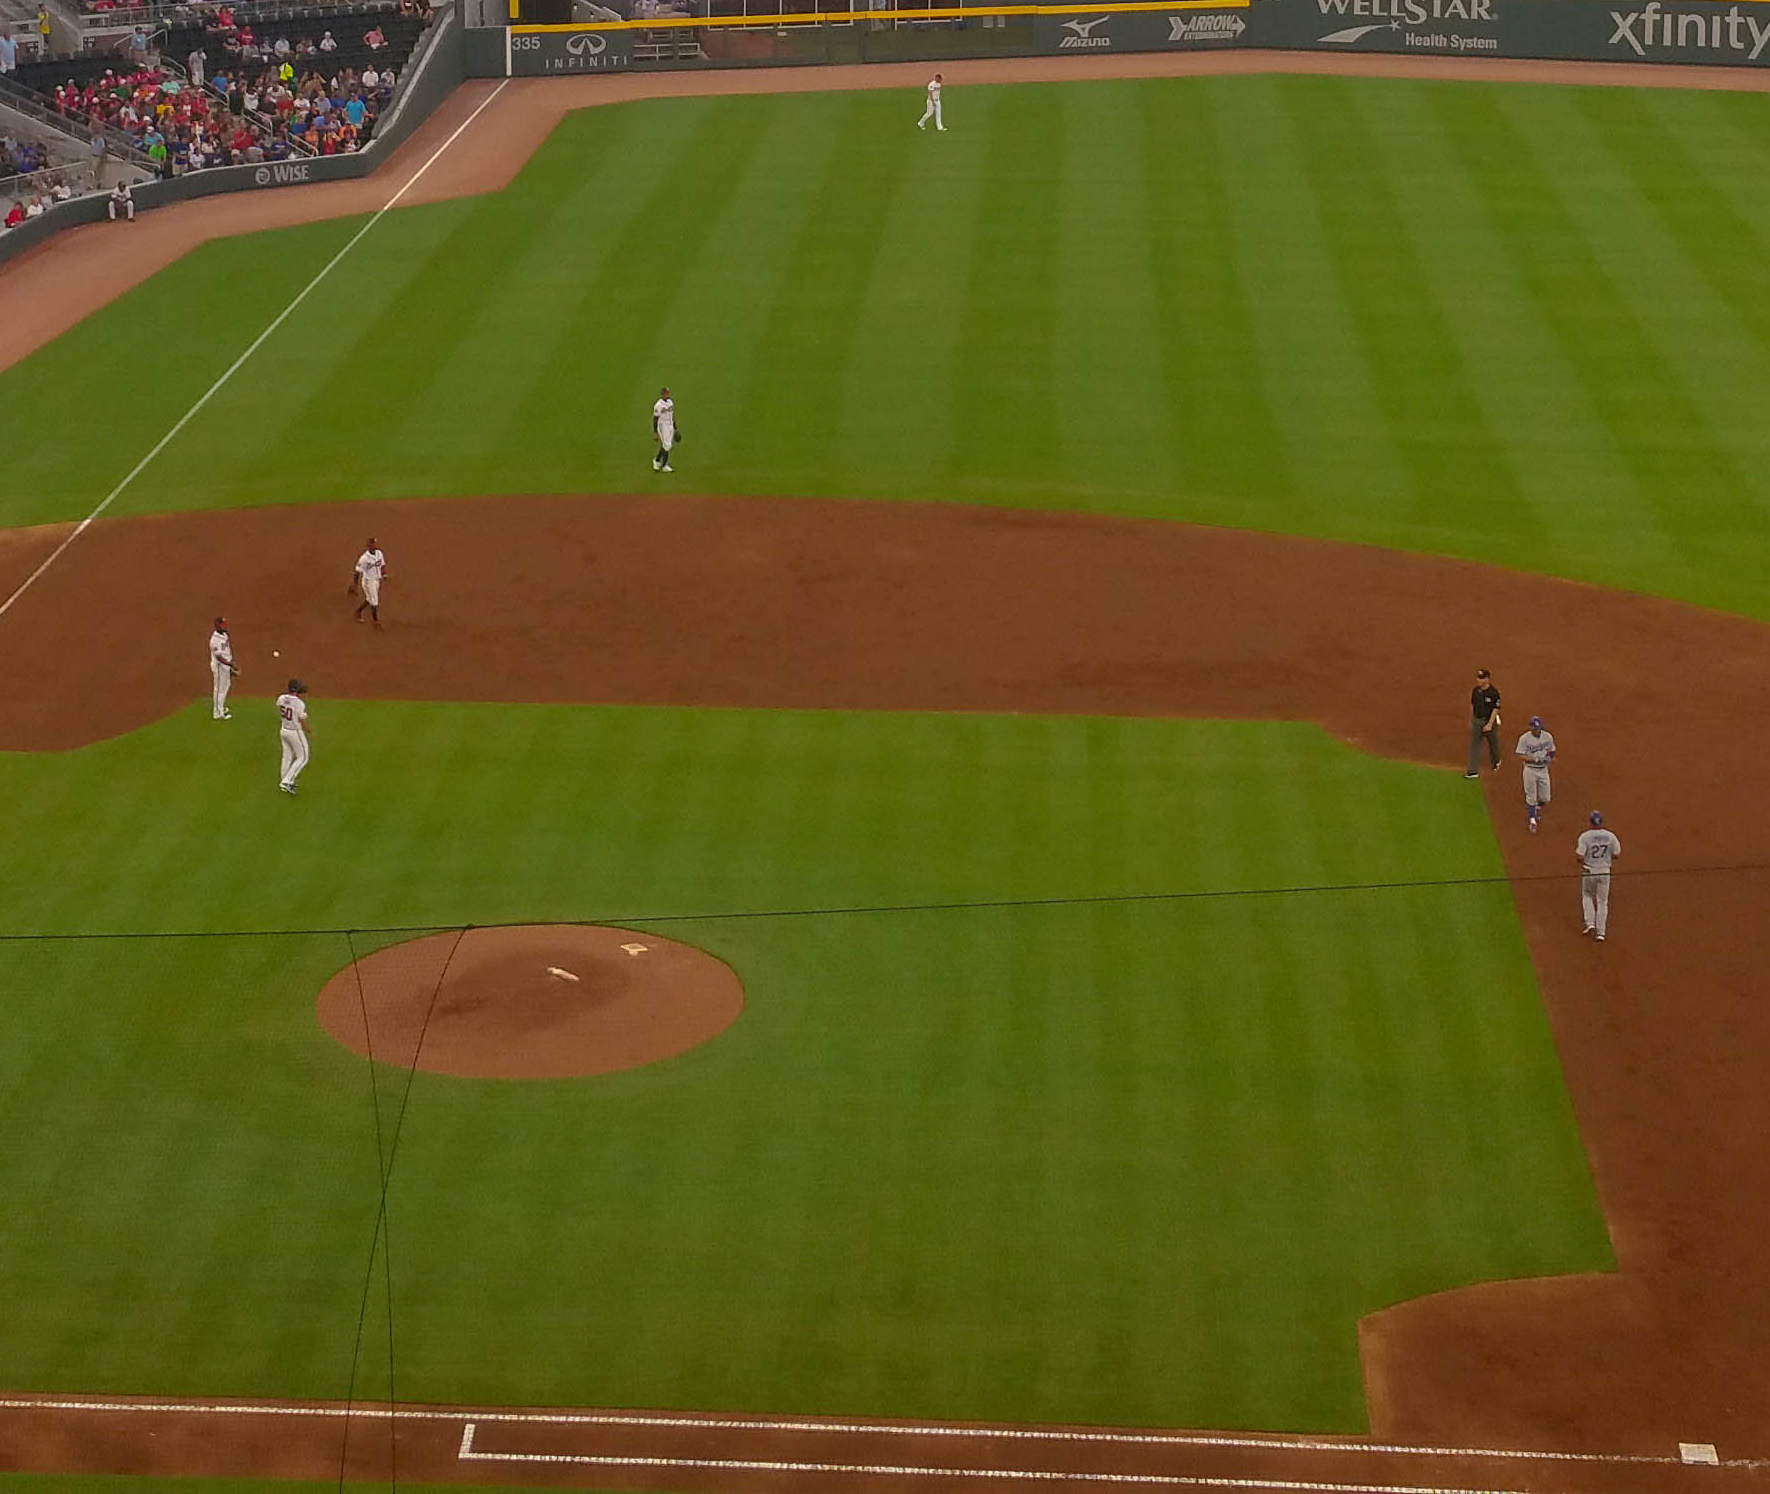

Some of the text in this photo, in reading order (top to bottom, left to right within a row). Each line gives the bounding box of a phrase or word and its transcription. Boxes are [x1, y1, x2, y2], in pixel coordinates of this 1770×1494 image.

[1187, 16, 1233, 32] ARROW
[511, 36, 541, 51] 335
[1405, 32, 1497, 51] Health System
[545, 57, 628, 69] INFINITI
[273, 164, 309, 182] WISE
[1591, 844, 1608, 858] 27
